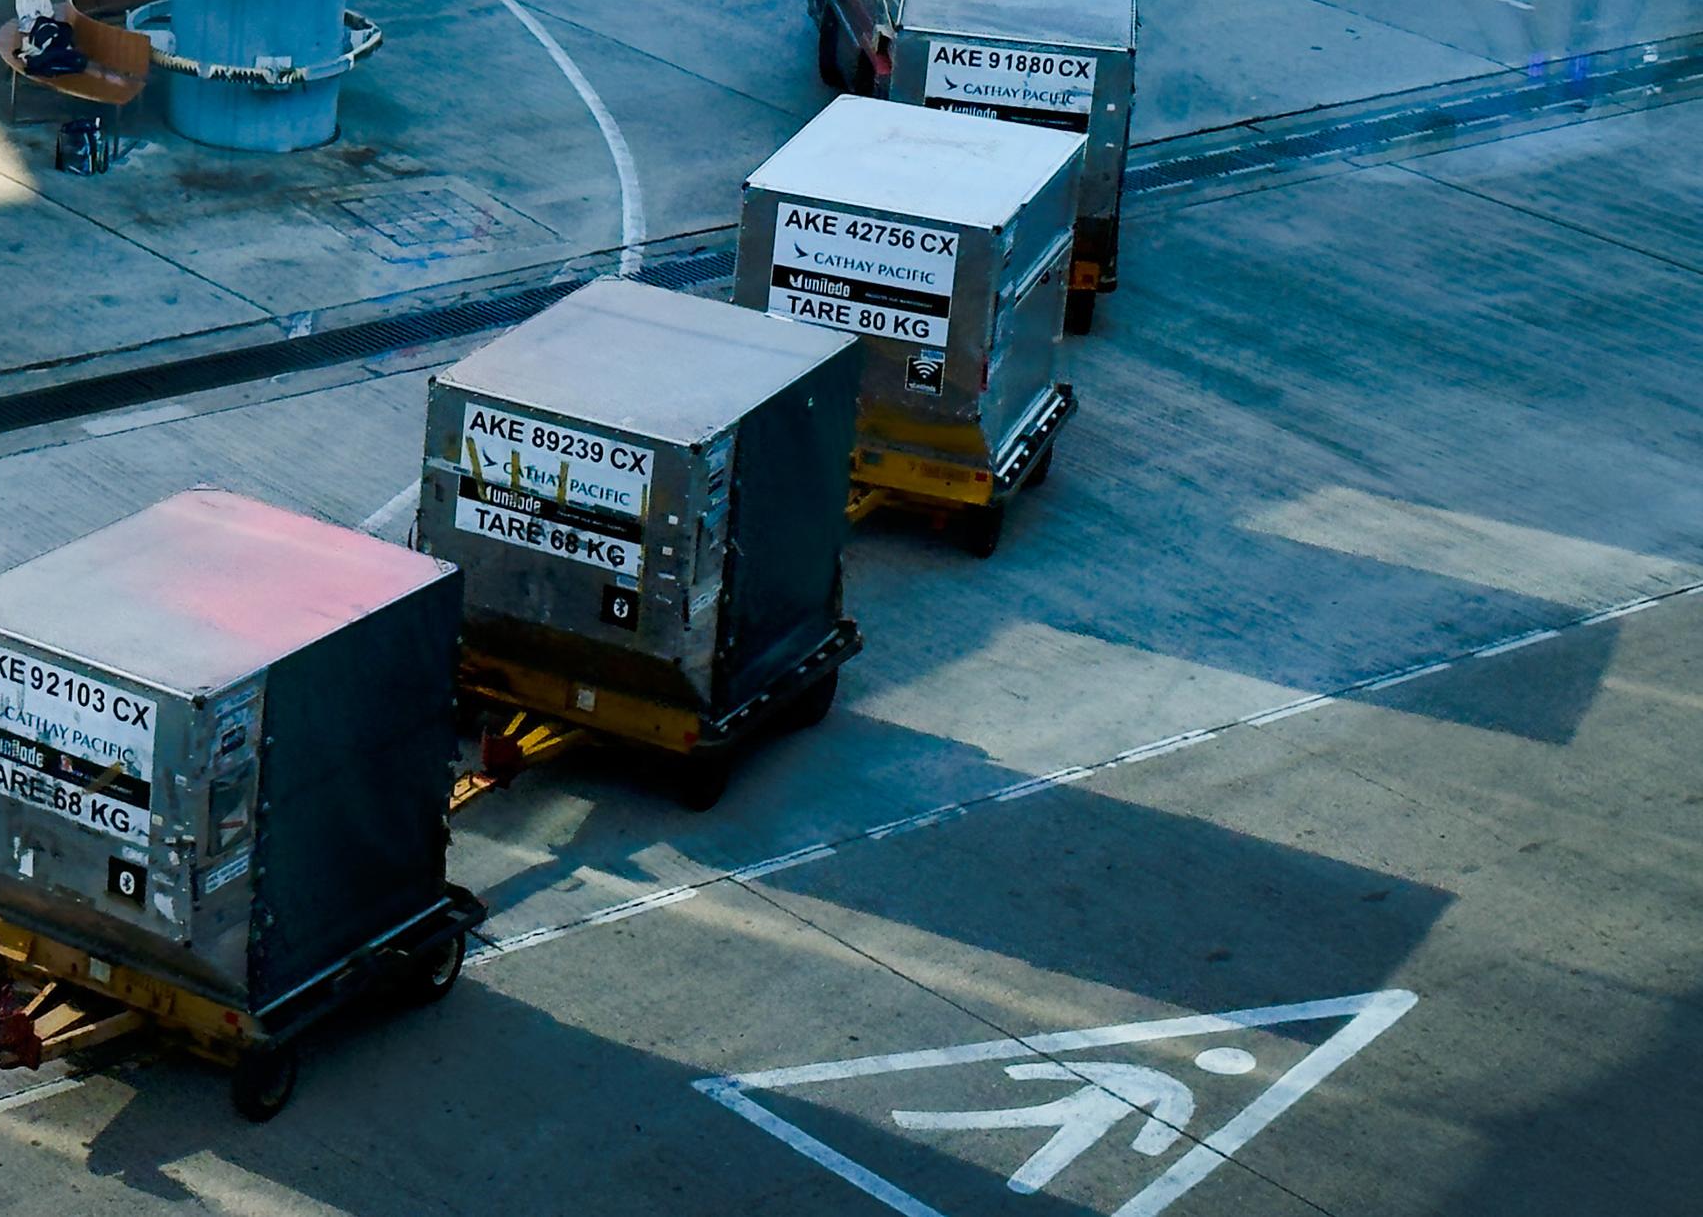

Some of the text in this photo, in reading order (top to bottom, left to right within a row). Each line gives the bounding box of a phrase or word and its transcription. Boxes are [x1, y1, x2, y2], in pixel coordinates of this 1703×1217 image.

[933, 46, 1091, 79] AKE 91880 CX
[963, 83, 1076, 106] CATHAY PACIFIC
[784, 209, 956, 257] AKE 42756 CX
[803, 277, 851, 298] unilode
[814, 251, 936, 285] CATHAY PACIFIC
[786, 294, 852, 326] TARE
[858, 309, 886, 331] 80
[893, 315, 930, 339] KG
[469, 410, 647, 476] AKE 89239 CX
[492, 488, 542, 514] unilode
[503, 461, 631, 506] CTHA PACIFIC
[475, 508, 542, 546] TARE
[550, 529, 580, 555] 68
[587, 538, 626, 568] KG
[30, 665, 106, 713] 92103
[112, 696, 151, 731] CX
[4, 704, 136, 763] CATHAY PACIFIC
[53, 786, 82, 816] 68
[90, 798, 131, 834] KG
